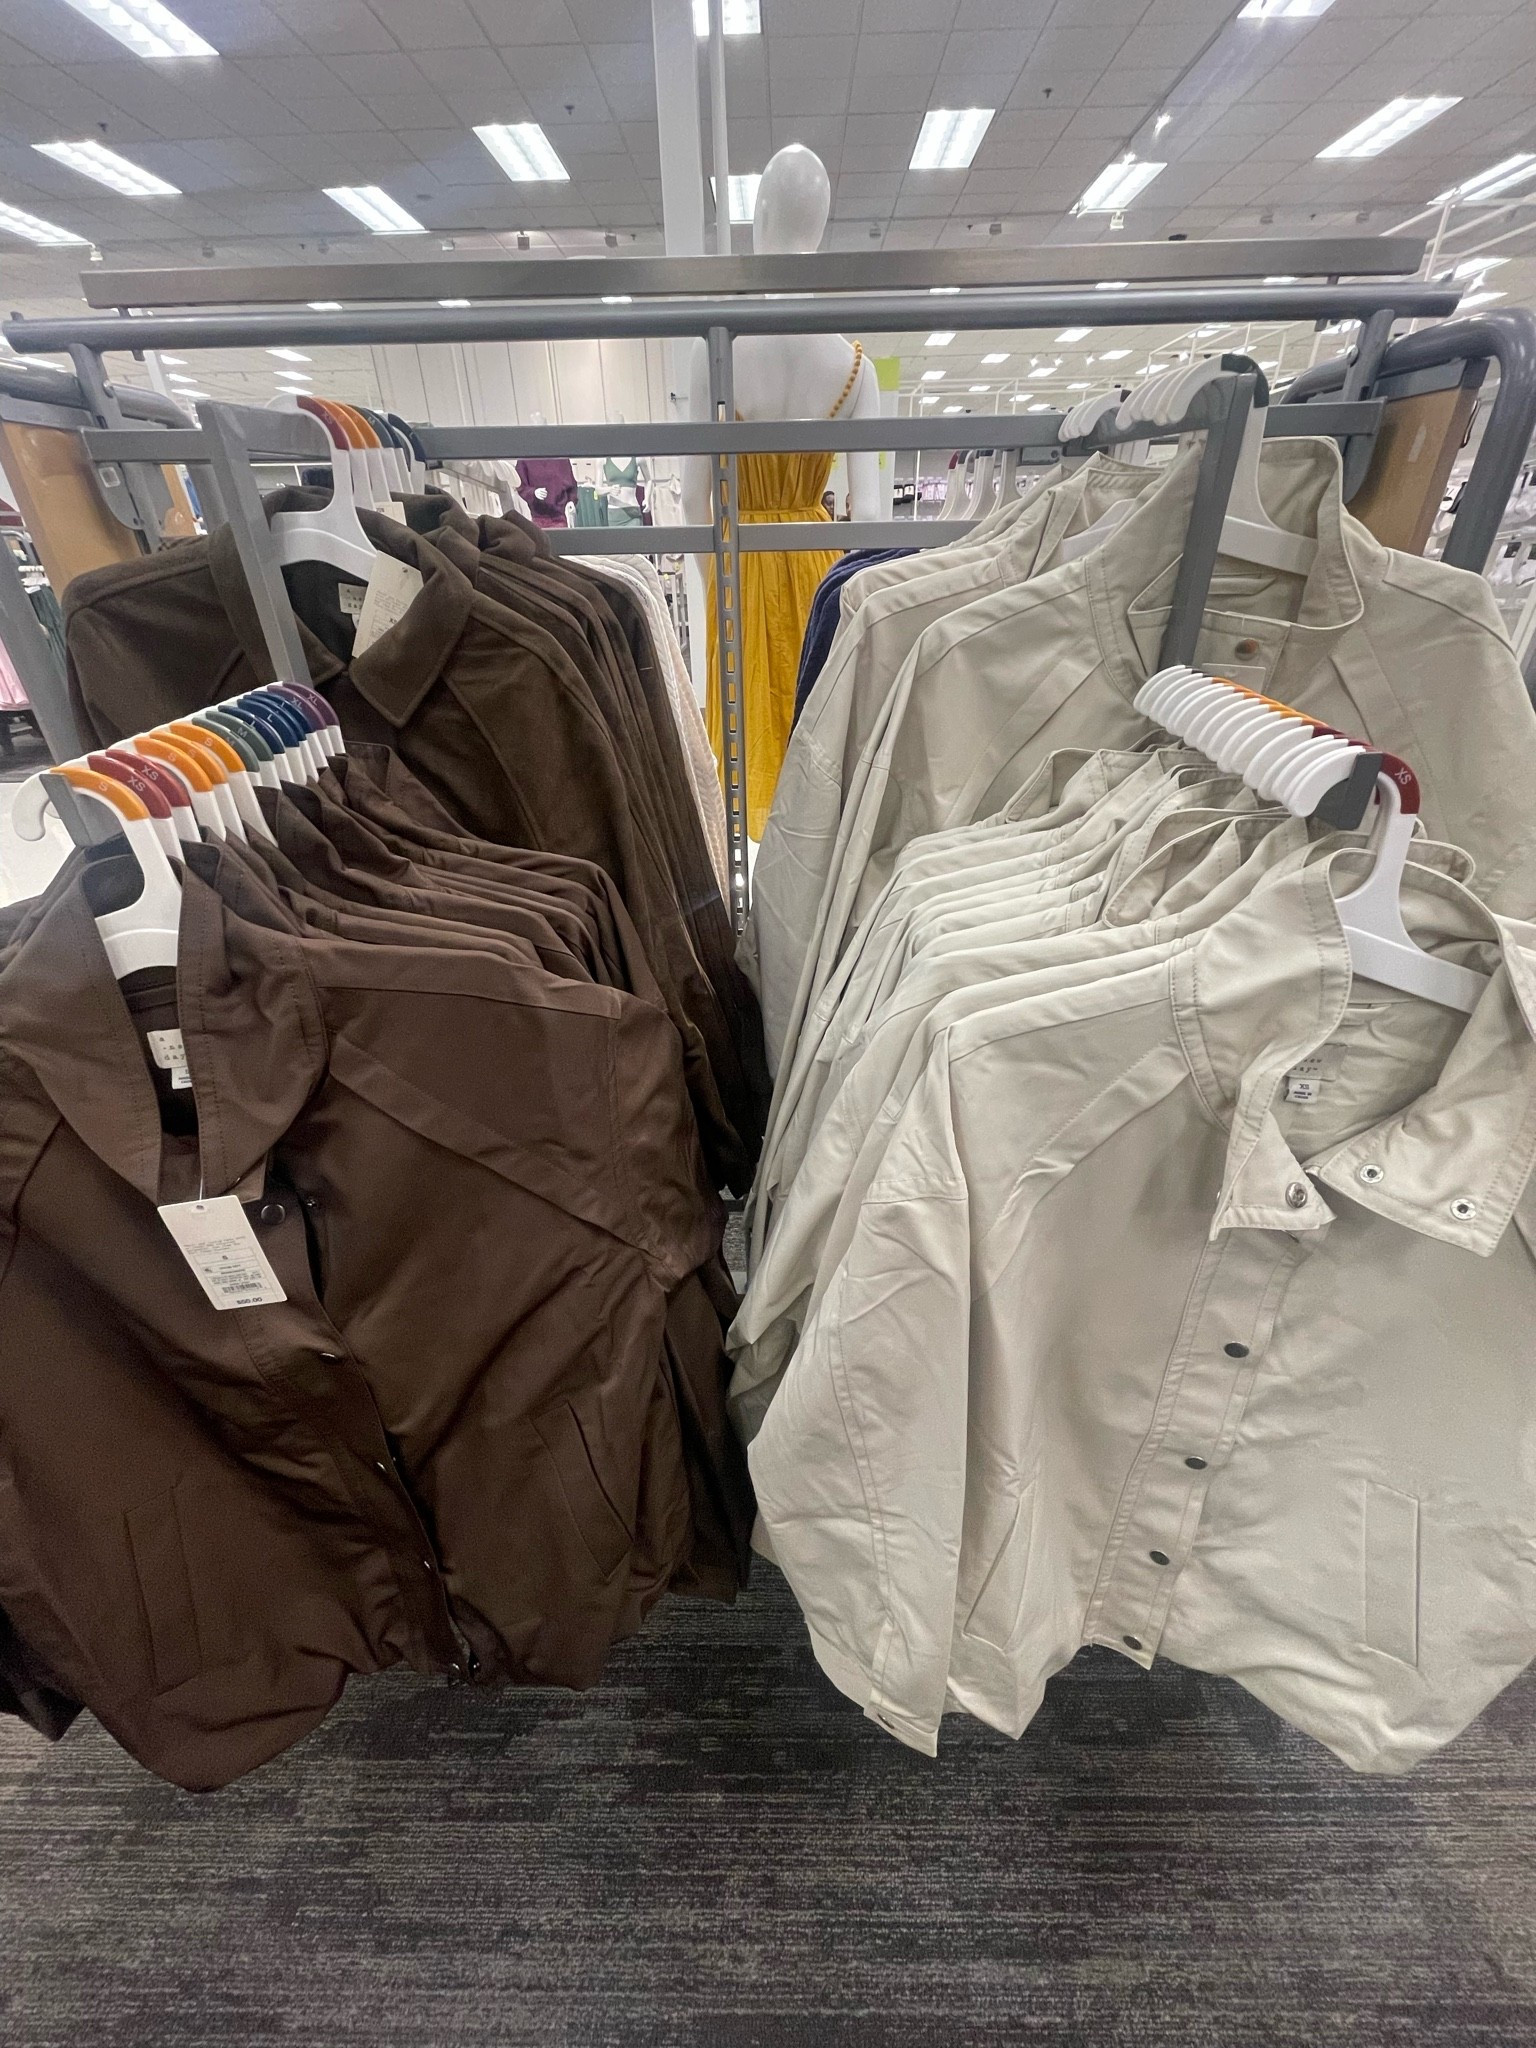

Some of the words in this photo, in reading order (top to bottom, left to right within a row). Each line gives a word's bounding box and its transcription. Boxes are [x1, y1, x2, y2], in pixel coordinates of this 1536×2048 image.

[291, 697, 303, 710] XL
[307, 693, 319, 706] XL
[267, 714, 273, 723] L
[238, 727, 248, 738] M
[205, 737, 214, 747] S
[167, 752, 177, 762] S
[141, 765, 159, 780] XS
[1394, 767, 1412, 785] XS
[98, 781, 108, 792] S
[127, 776, 146, 792] XS
